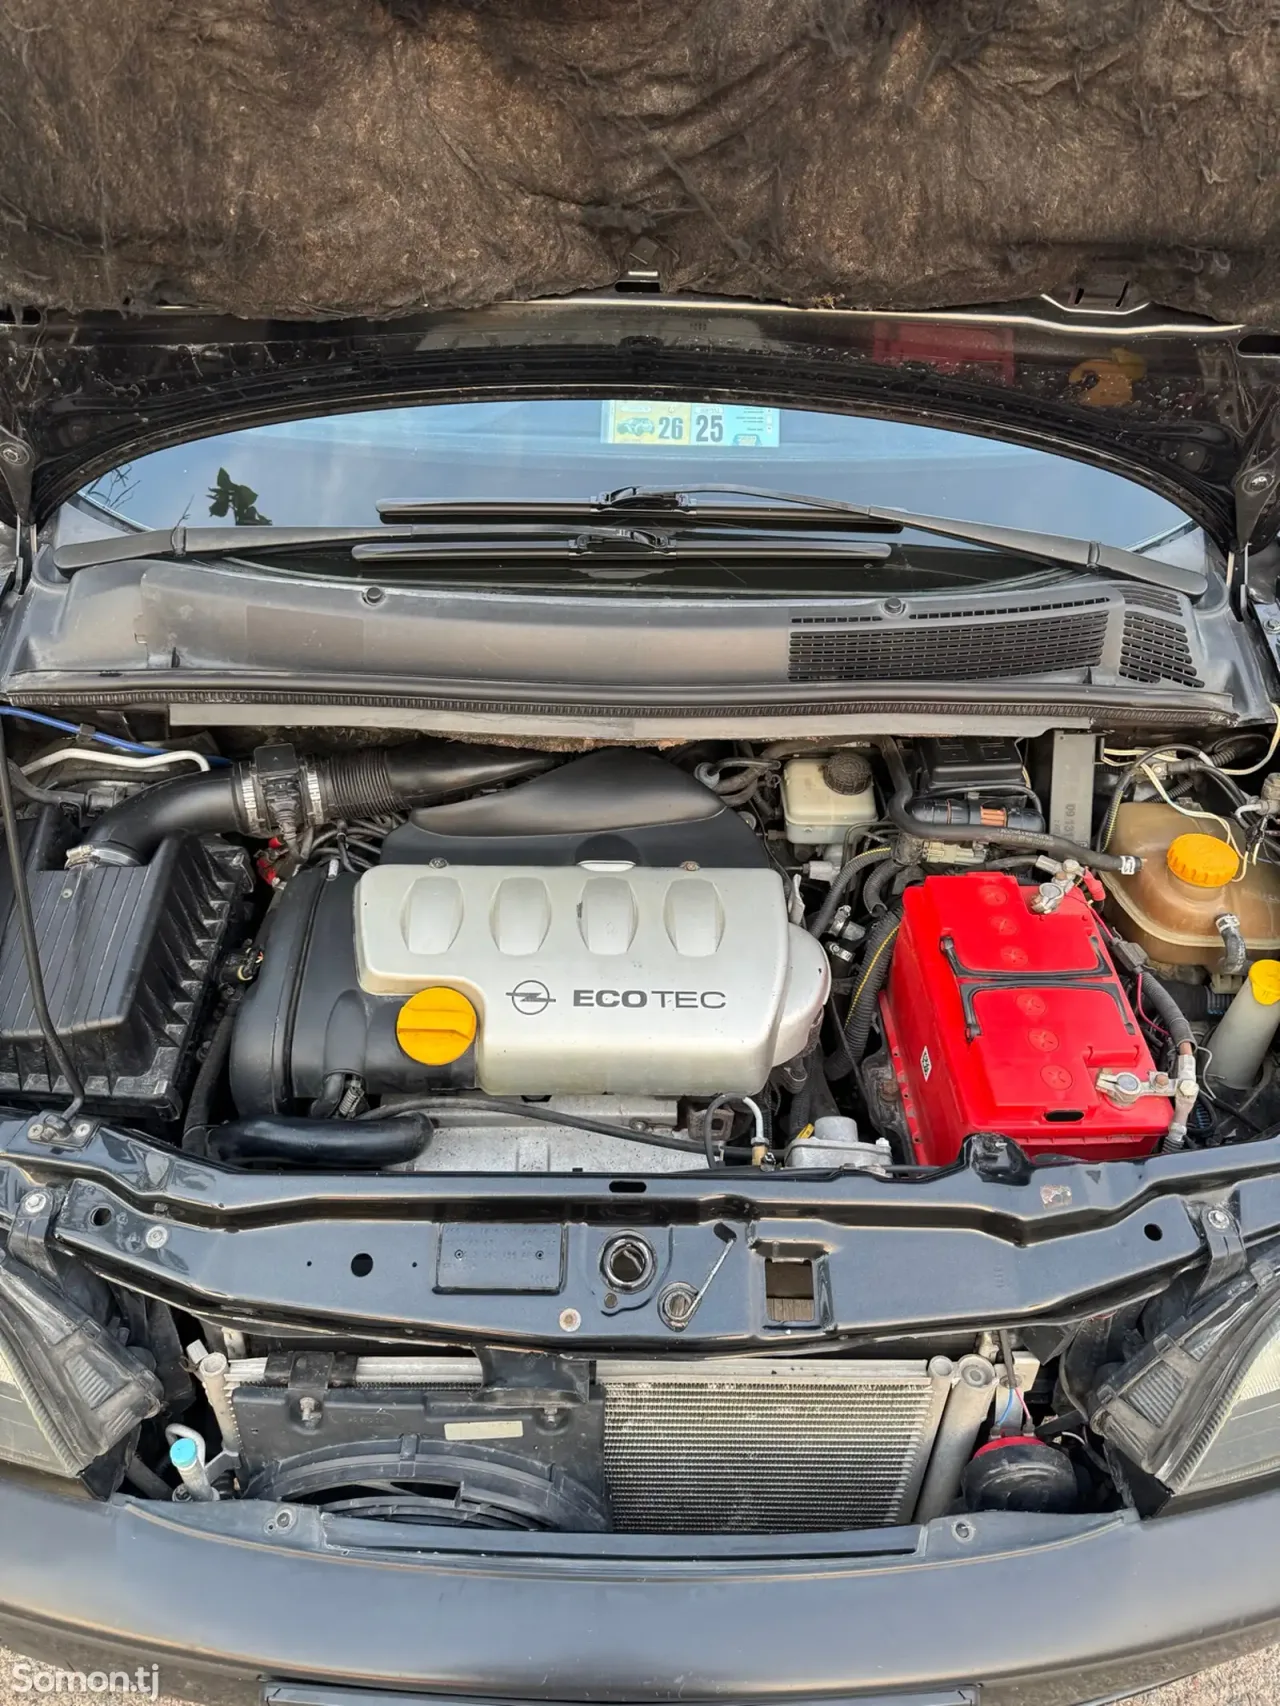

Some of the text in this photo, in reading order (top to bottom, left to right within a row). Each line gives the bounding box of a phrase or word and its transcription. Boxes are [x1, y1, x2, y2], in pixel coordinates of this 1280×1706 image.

[658, 416, 684, 440] 26
[695, 414, 724, 443] 25
[573, 989, 727, 1009] ECOTEC
